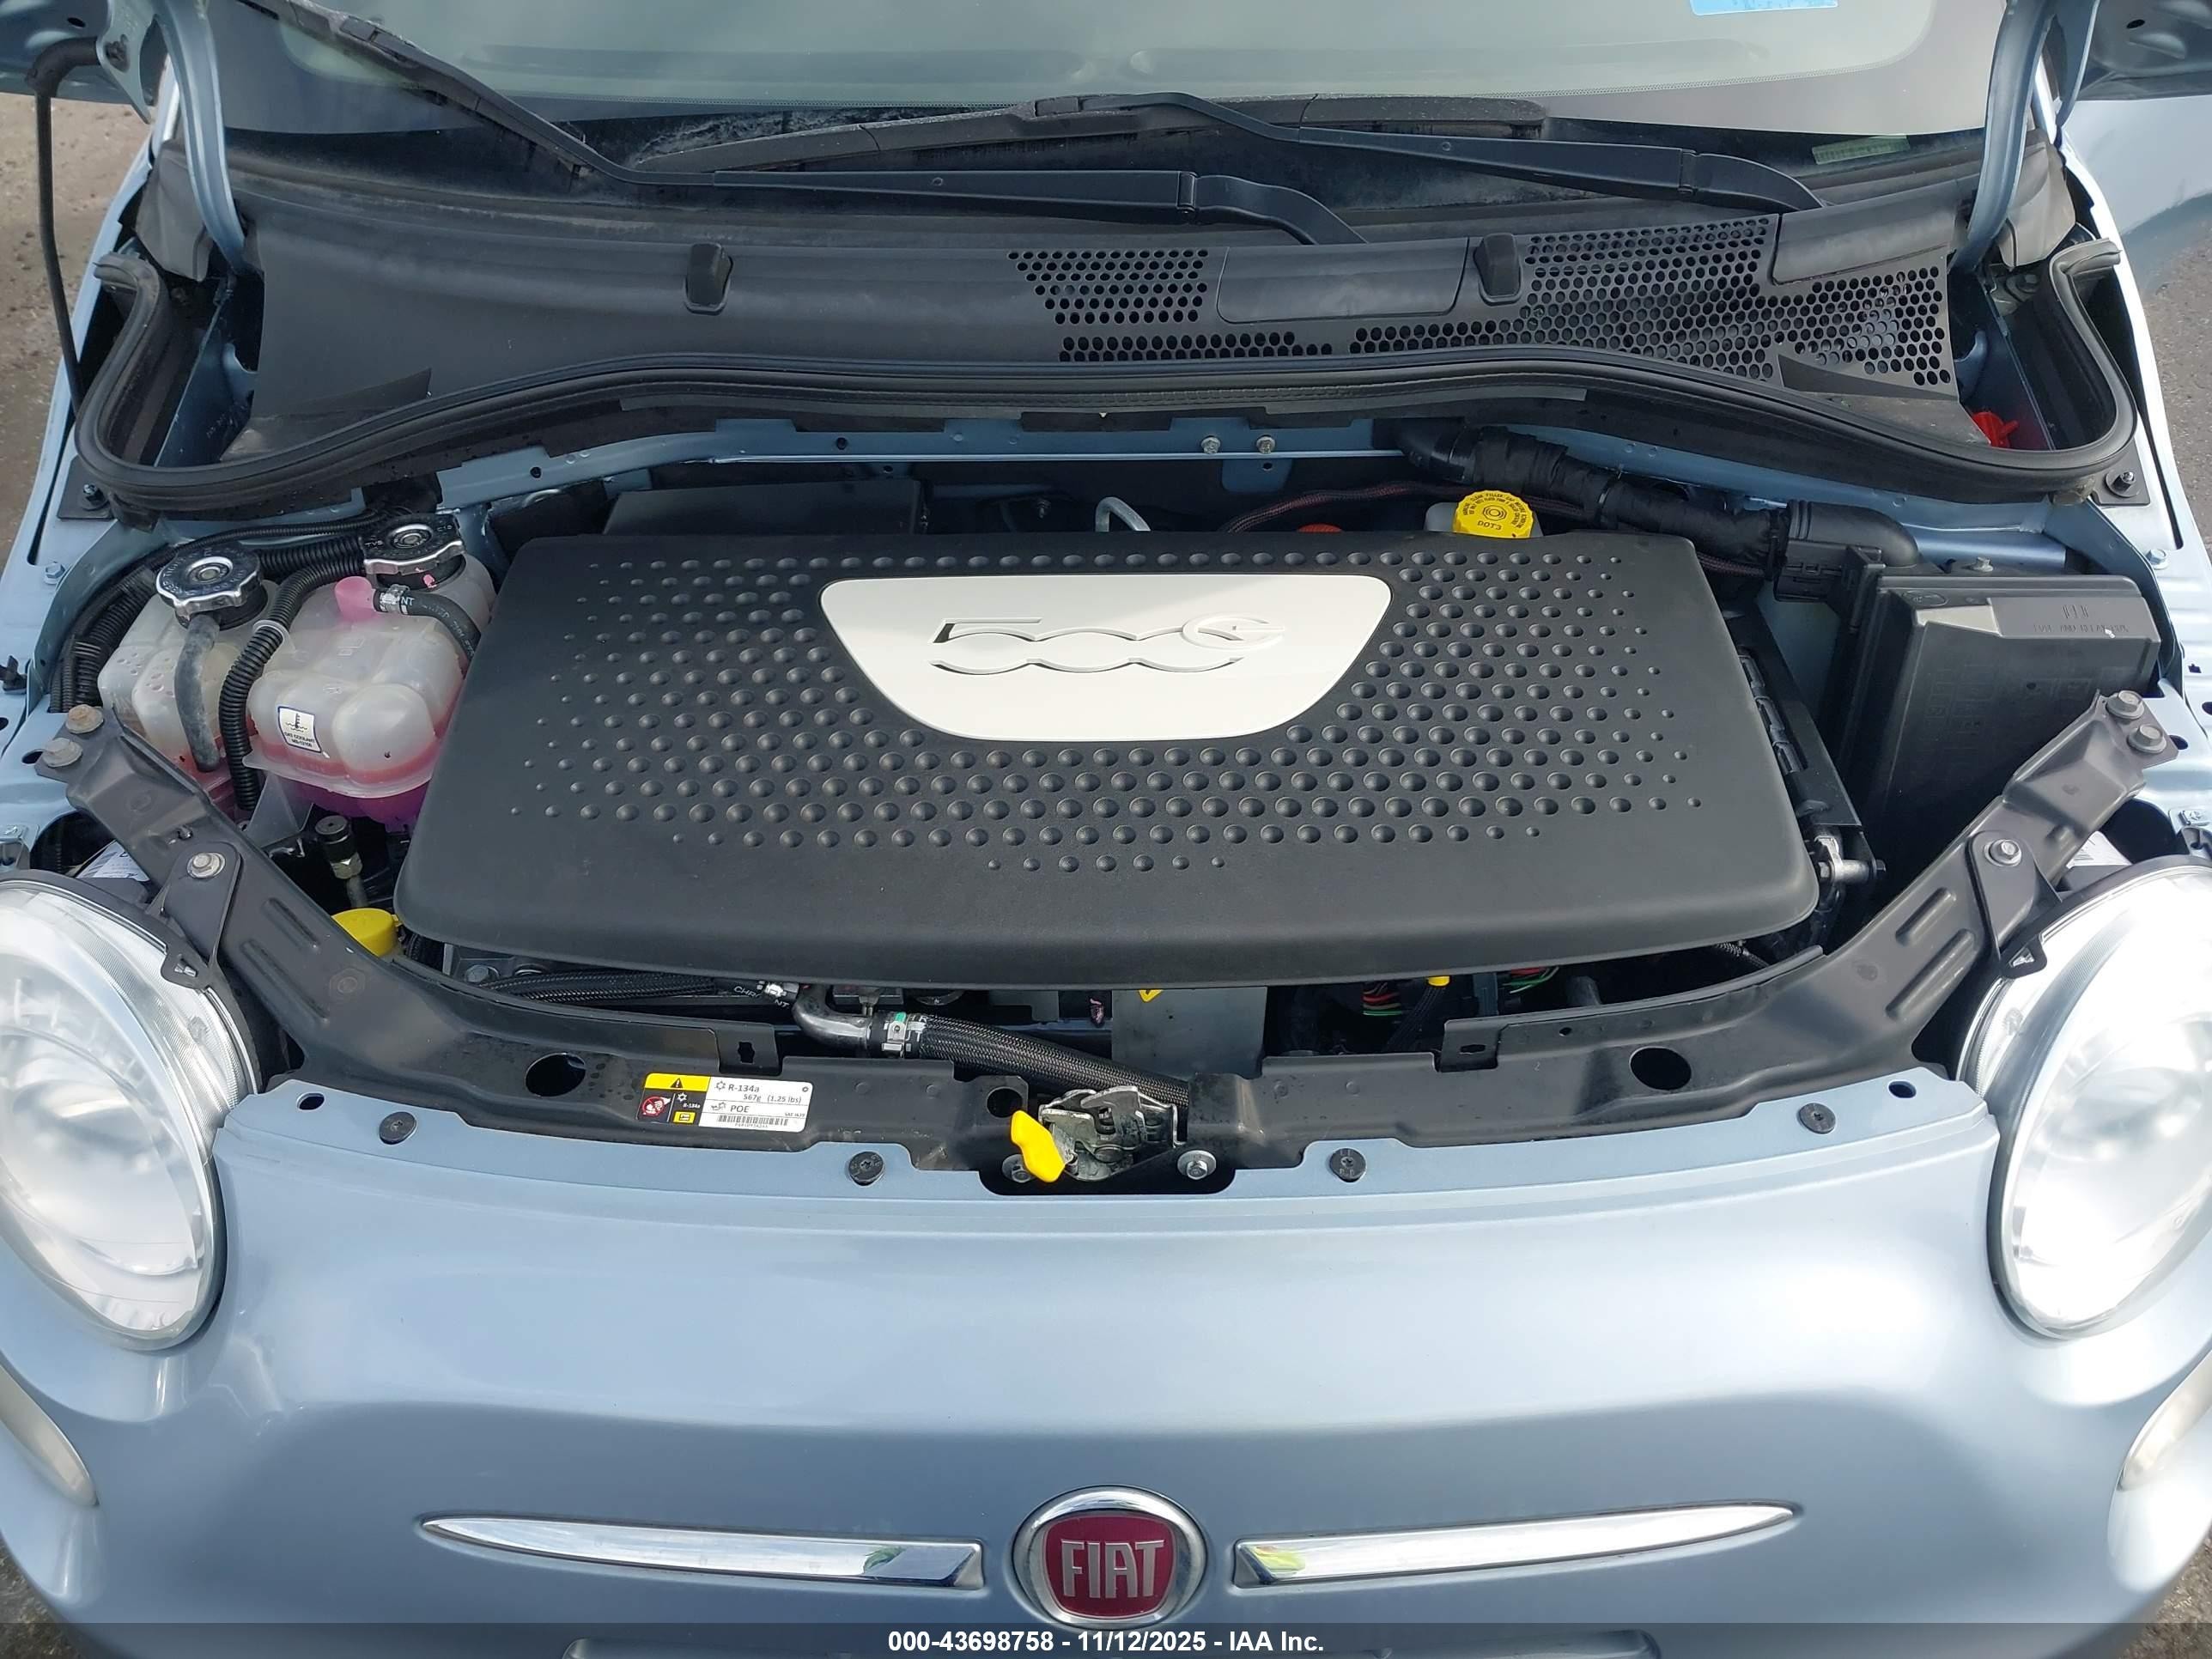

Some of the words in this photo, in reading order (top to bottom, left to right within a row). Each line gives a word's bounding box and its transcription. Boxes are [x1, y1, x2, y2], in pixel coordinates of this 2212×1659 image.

[728, 1084, 760, 1094] R-134a
[744, 1093, 762, 1103] 567g
[767, 1094, 787, 1103] (1.25
[788, 1095, 802, 1104] lbs)
[730, 1105, 750, 1114] POE
[1061, 1539, 1164, 1599] FIAT
